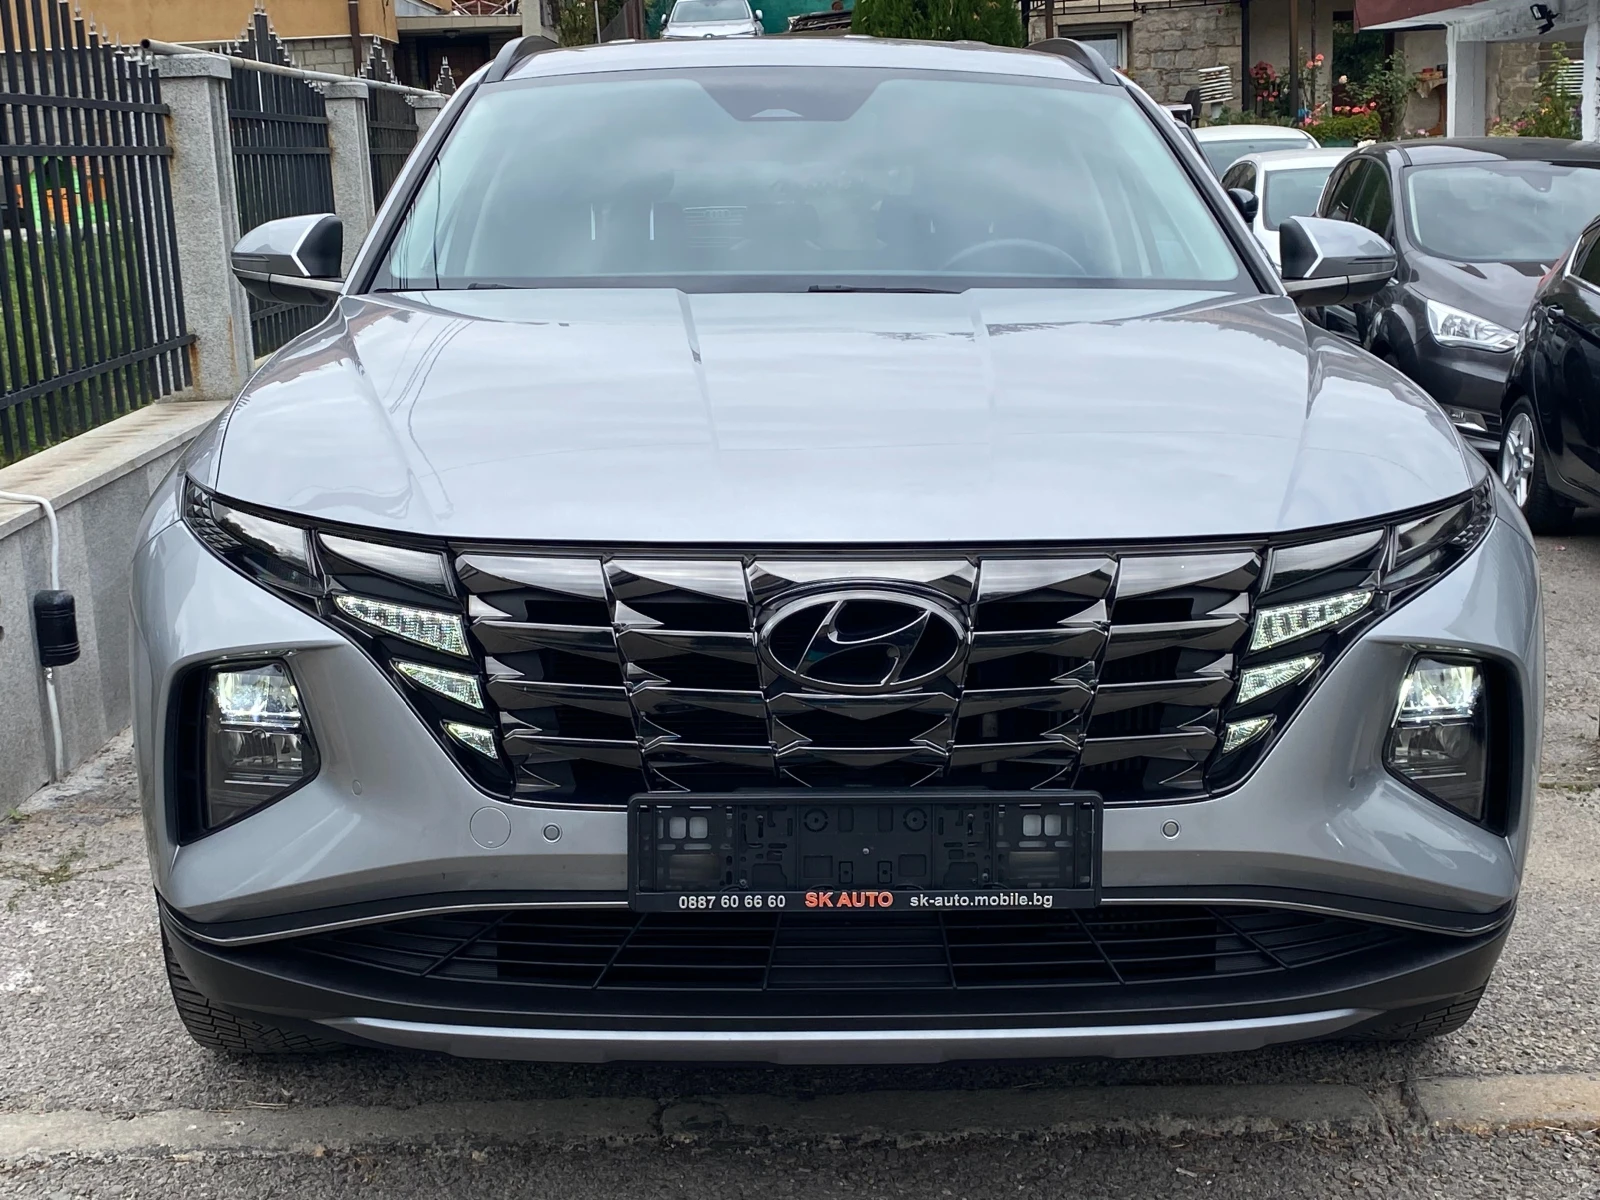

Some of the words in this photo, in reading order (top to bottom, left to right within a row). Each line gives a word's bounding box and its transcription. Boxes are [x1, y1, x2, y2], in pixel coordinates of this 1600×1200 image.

[678, 895, 716, 909] 0887
[720, 895, 739, 908] 60
[744, 895, 763, 908] 66
[767, 895, 786, 908] 60
[804, 891, 834, 908] SK
[836, 891, 894, 908] AUTO
[909, 892, 1053, 908] sk-auto.mobile.bg
